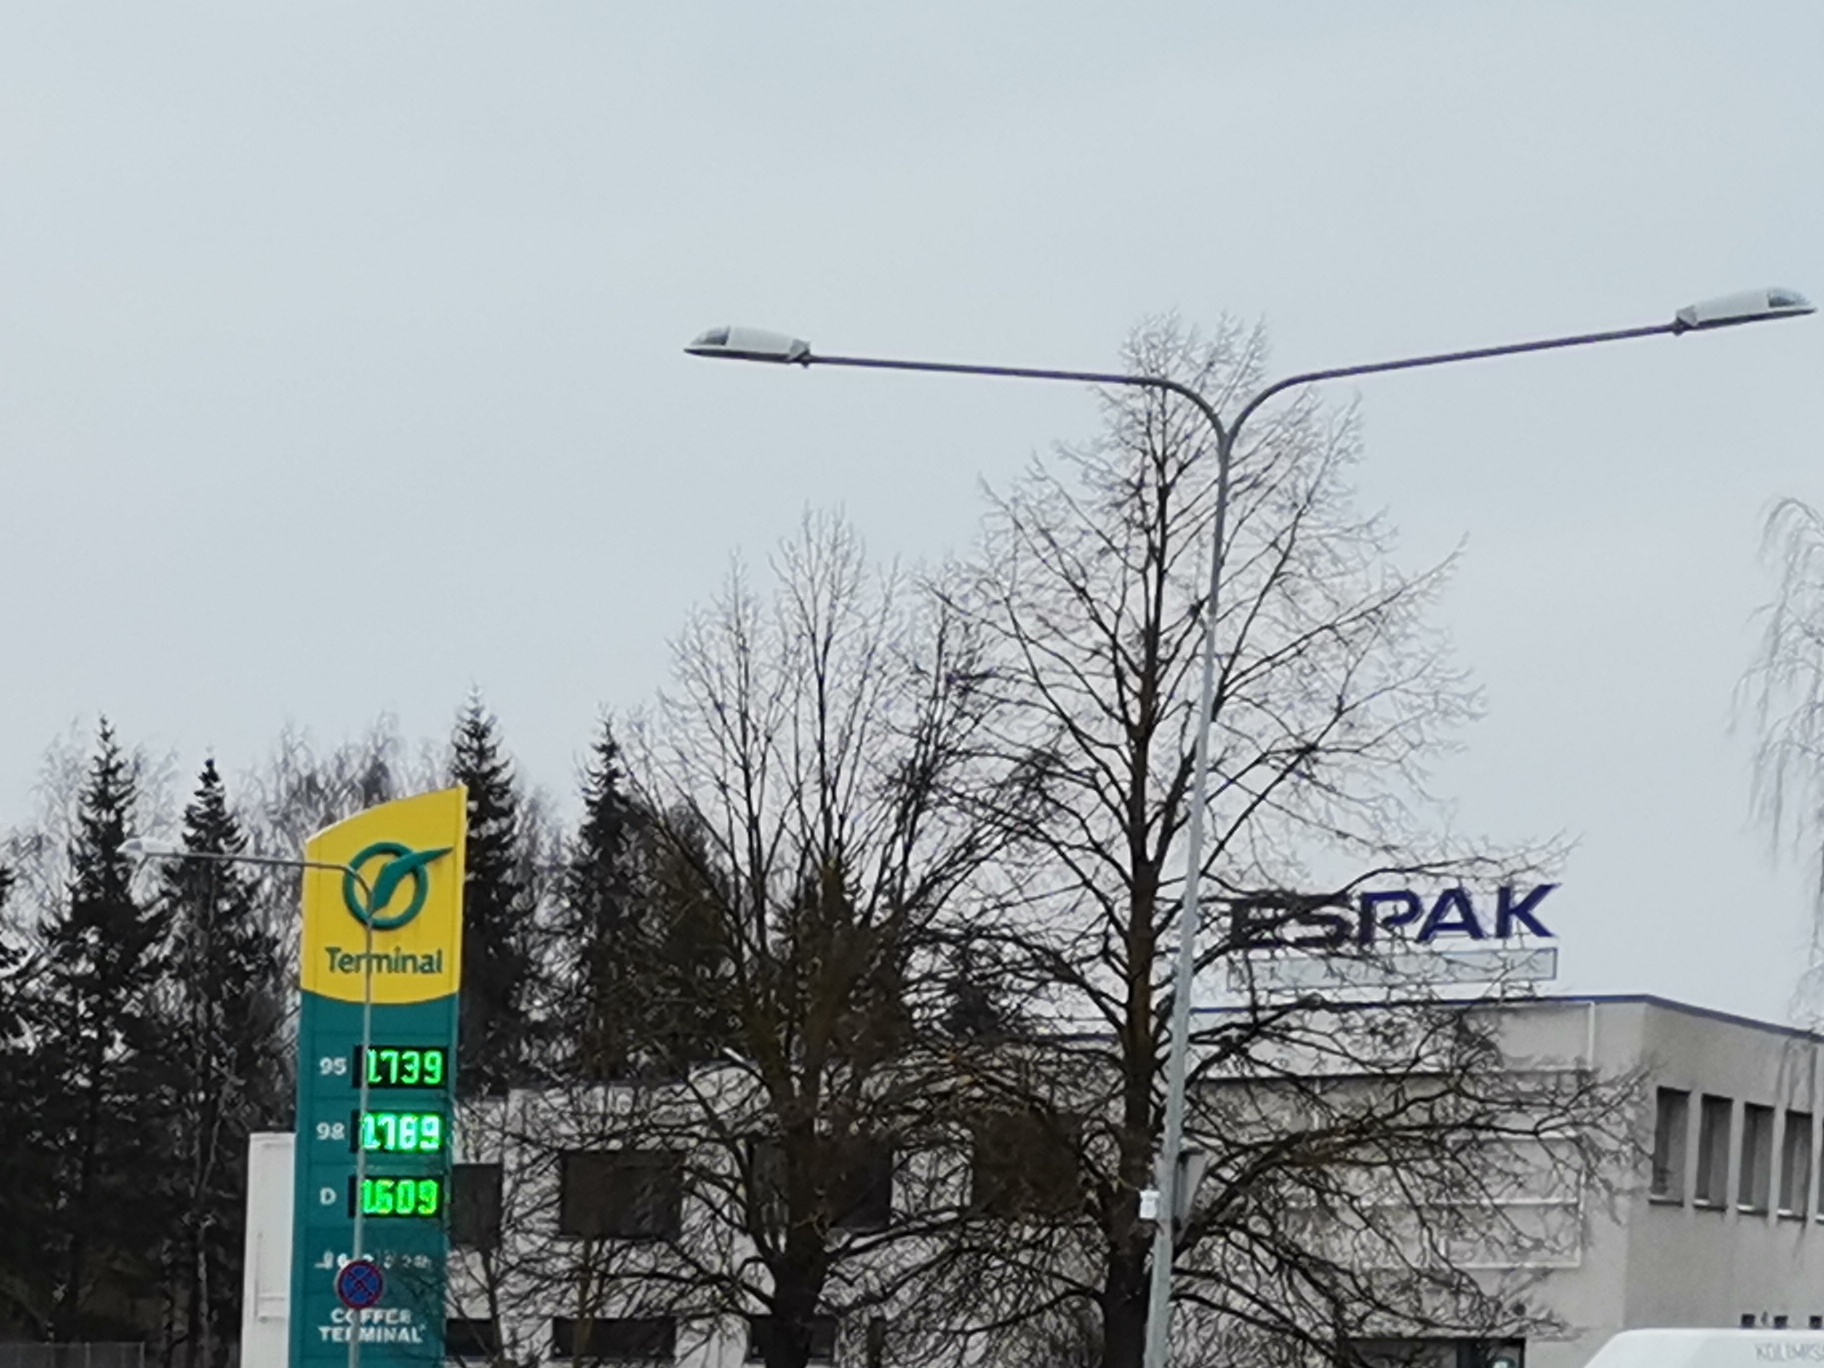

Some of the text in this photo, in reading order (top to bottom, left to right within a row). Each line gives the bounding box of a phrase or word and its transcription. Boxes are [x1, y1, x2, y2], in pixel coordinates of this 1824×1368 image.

[1230, 883, 1562, 948] ESPAK
[324, 945, 444, 975] Terminal
[319, 1056, 347, 1076] 95
[316, 1122, 345, 1140] 98
[319, 1187, 337, 1205] D
